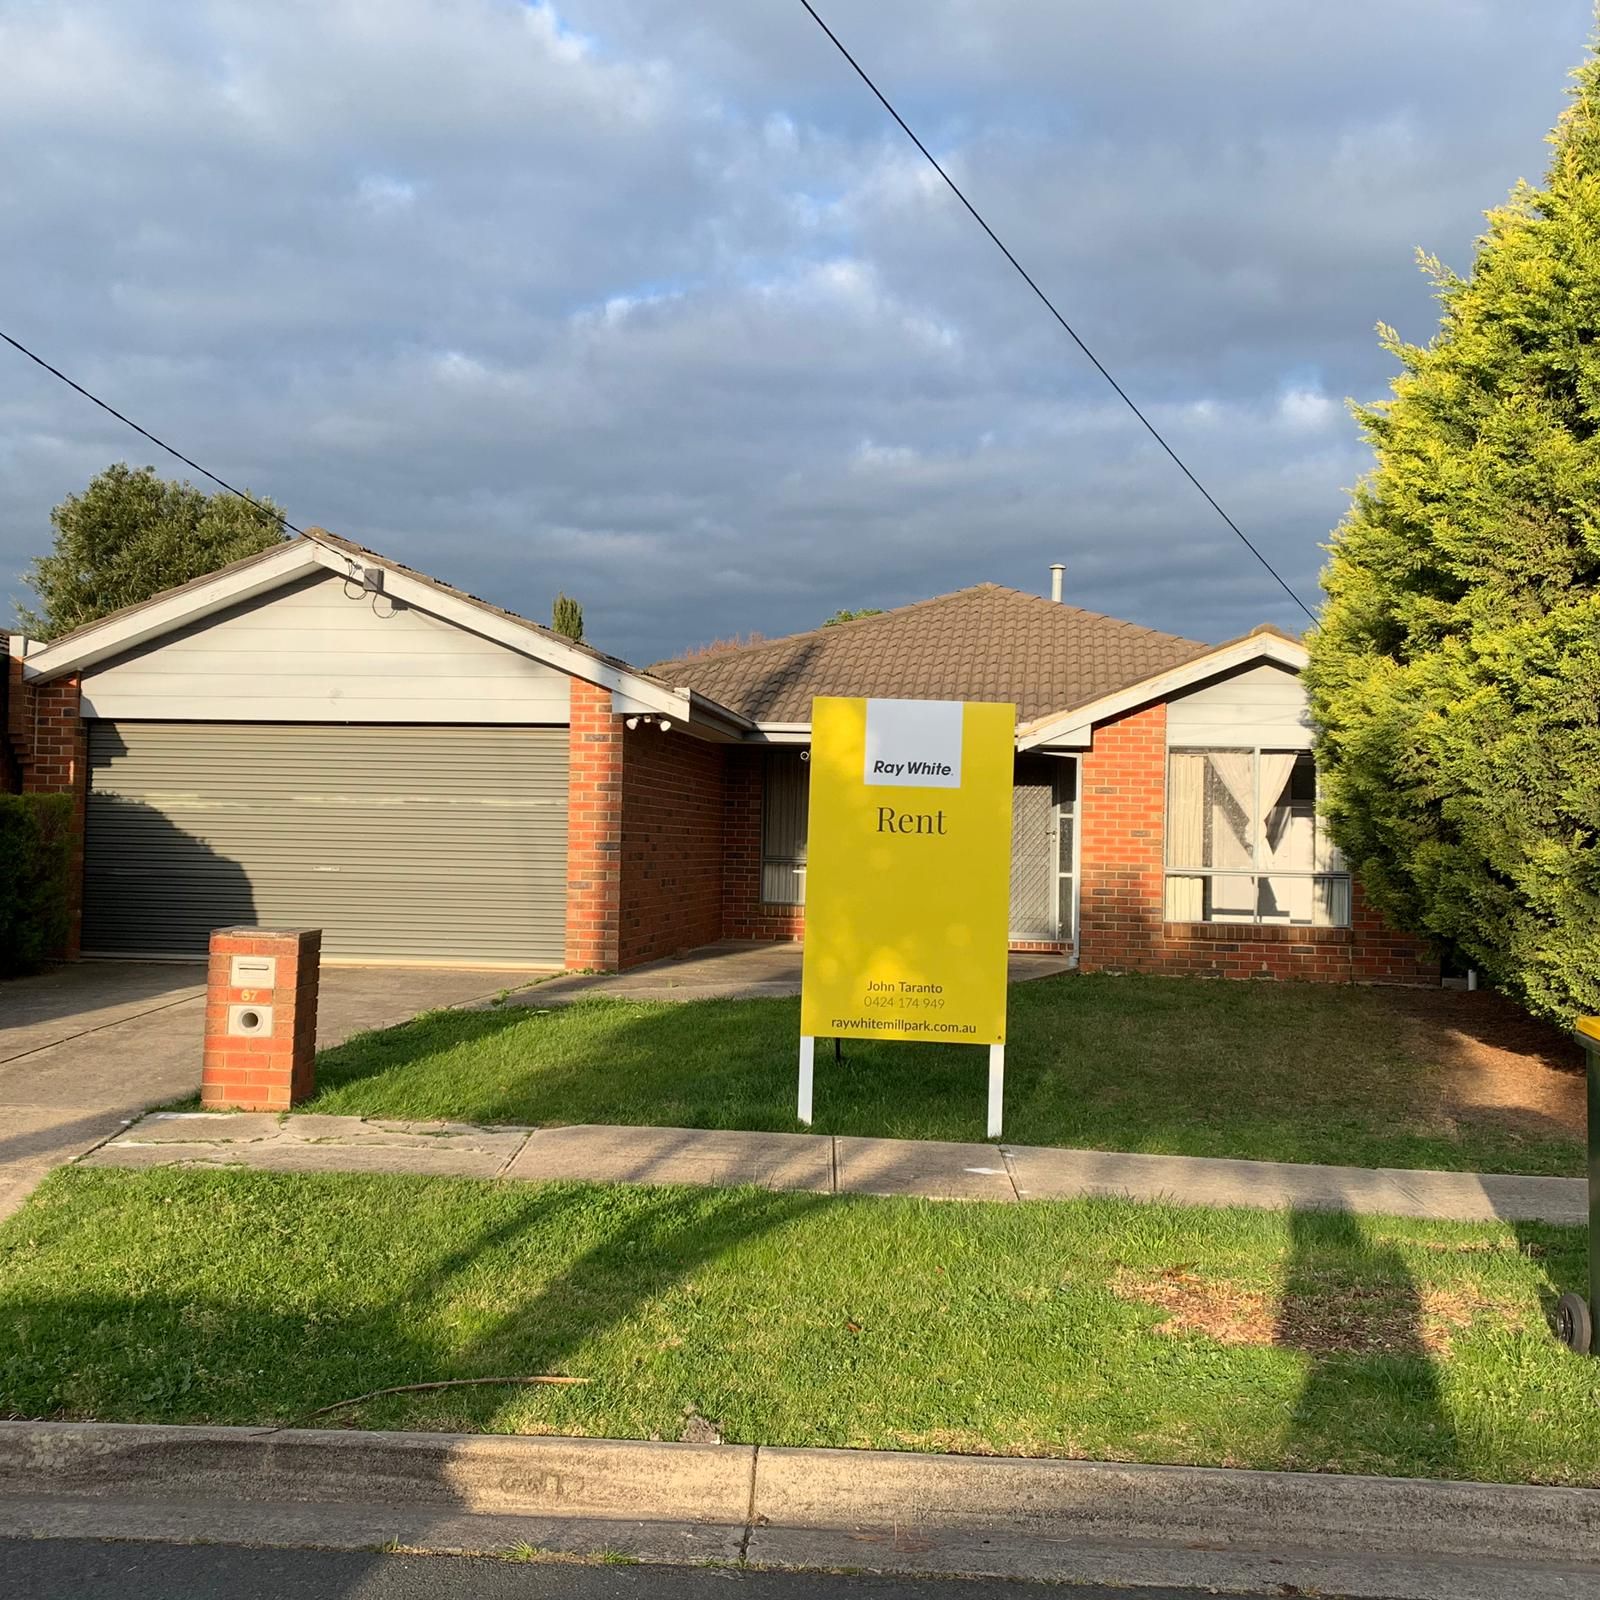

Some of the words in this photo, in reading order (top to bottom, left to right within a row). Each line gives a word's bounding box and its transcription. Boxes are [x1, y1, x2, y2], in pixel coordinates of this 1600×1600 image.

[873, 760, 904, 776] Ray
[907, 761, 952, 776] White
[876, 806, 948, 835] Rent
[867, 980, 895, 992] John
[898, 981, 943, 994] Taranto
[241, 989, 258, 1002] 67
[864, 995, 894, 1008] 0424
[898, 996, 919, 1009] 174
[922, 997, 945, 1009] 949
[831, 1017, 977, 1034] raywhitemillpark.com.au
